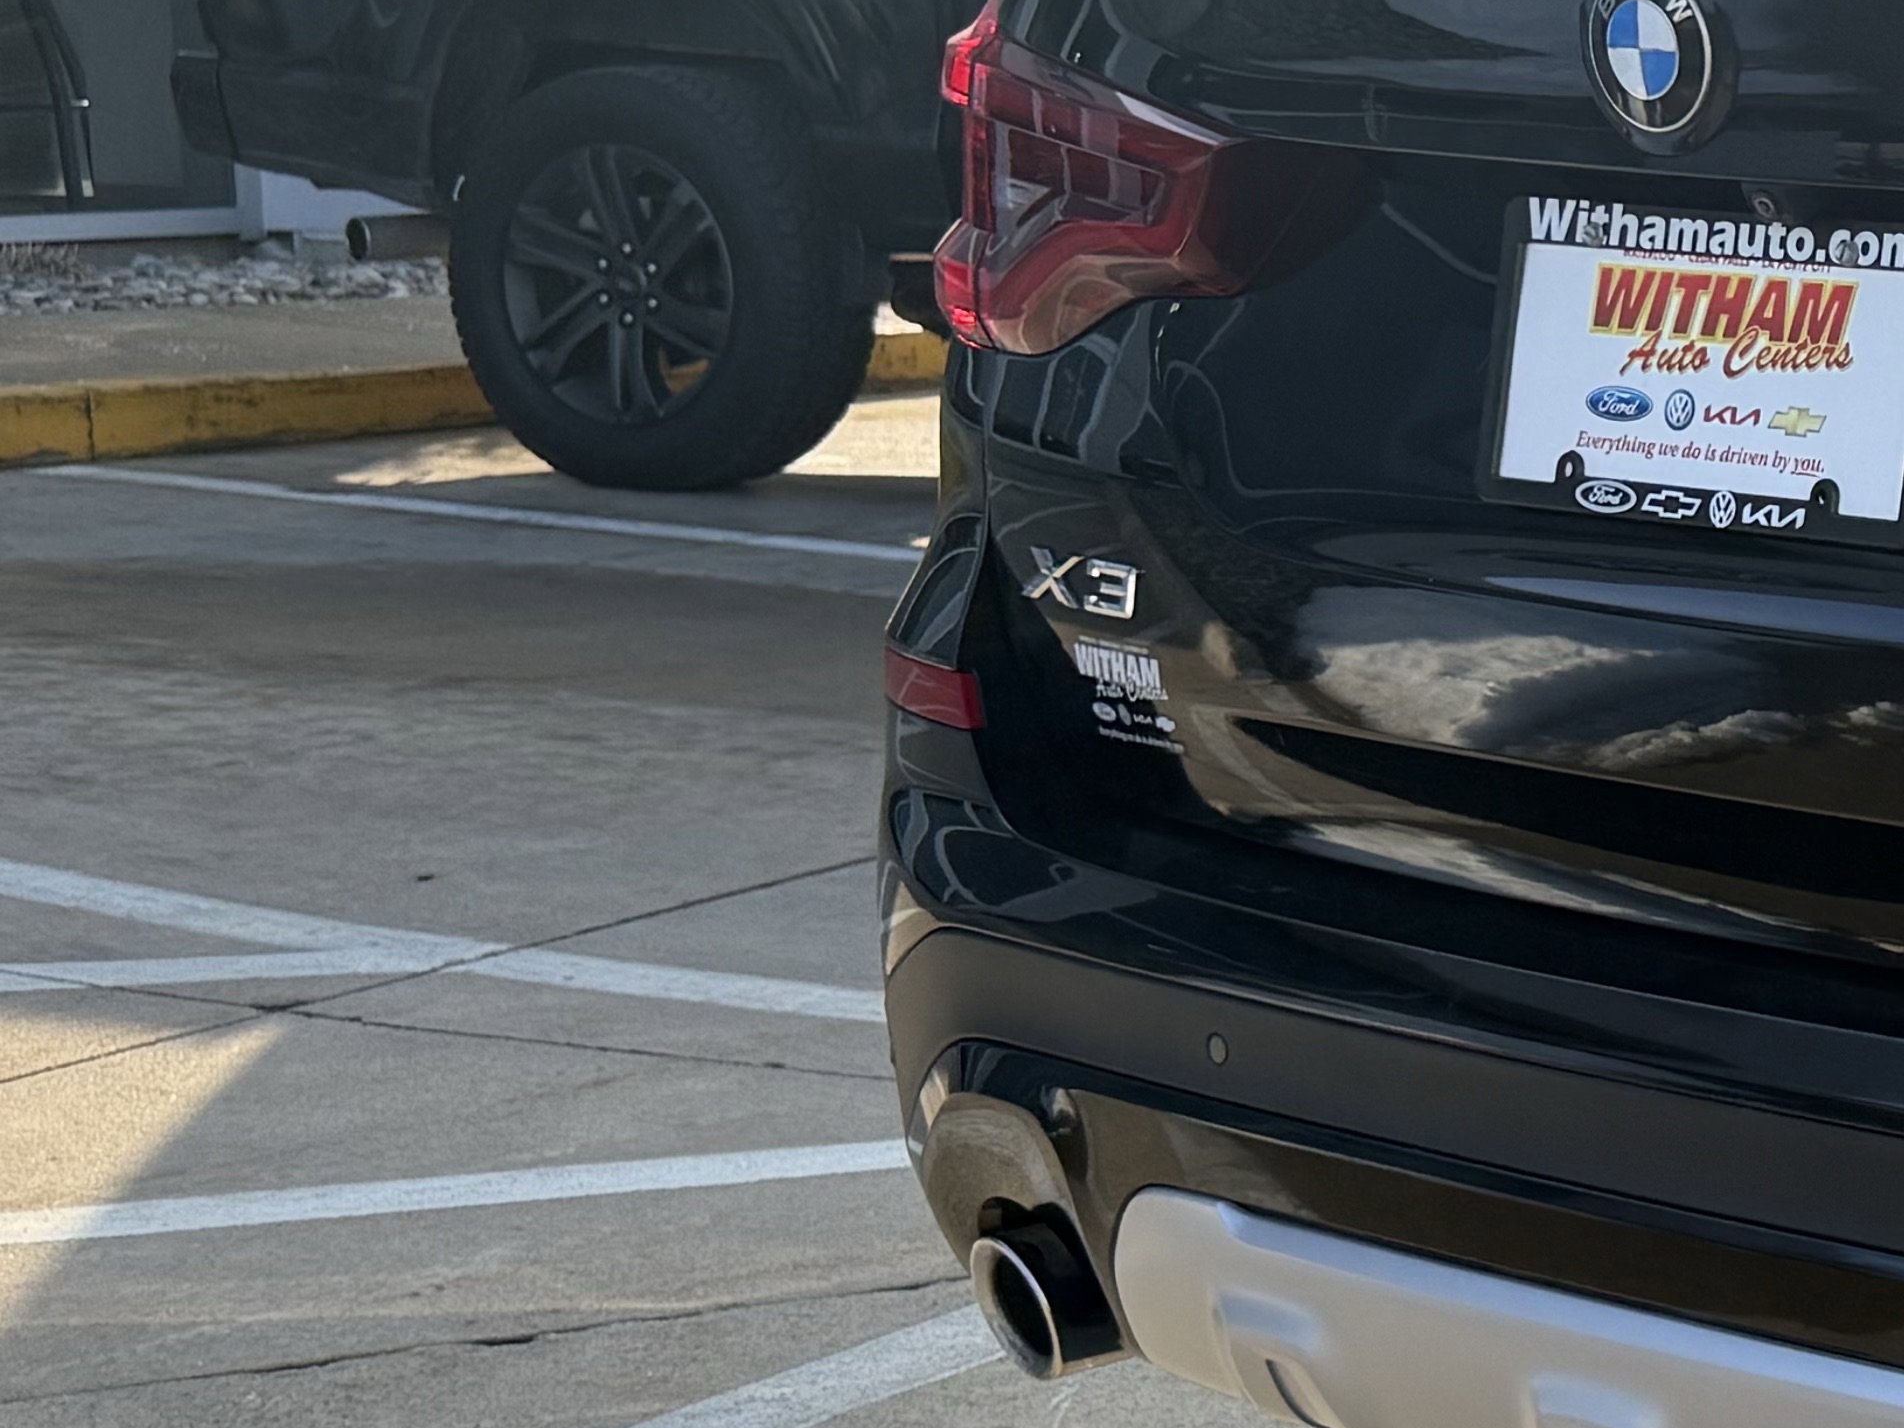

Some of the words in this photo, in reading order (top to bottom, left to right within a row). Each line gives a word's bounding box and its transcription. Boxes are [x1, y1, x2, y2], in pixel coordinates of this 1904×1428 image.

[1589, 262, 1860, 346] WITHAM
[1620, 334, 1711, 376] Auto
[1723, 327, 1854, 379] Centers
[1576, 430, 1655, 460] Everything
[1658, 443, 1680, 458] we
[1681, 443, 1700, 460] do
[1704, 444, 1717, 461] is
[1718, 445, 1768, 467] driven
[1772, 450, 1791, 474] by
[1792, 457, 1825, 476] you.
[1021, 546, 1137, 619] X3
[1073, 642, 1161, 689] WITHAM
